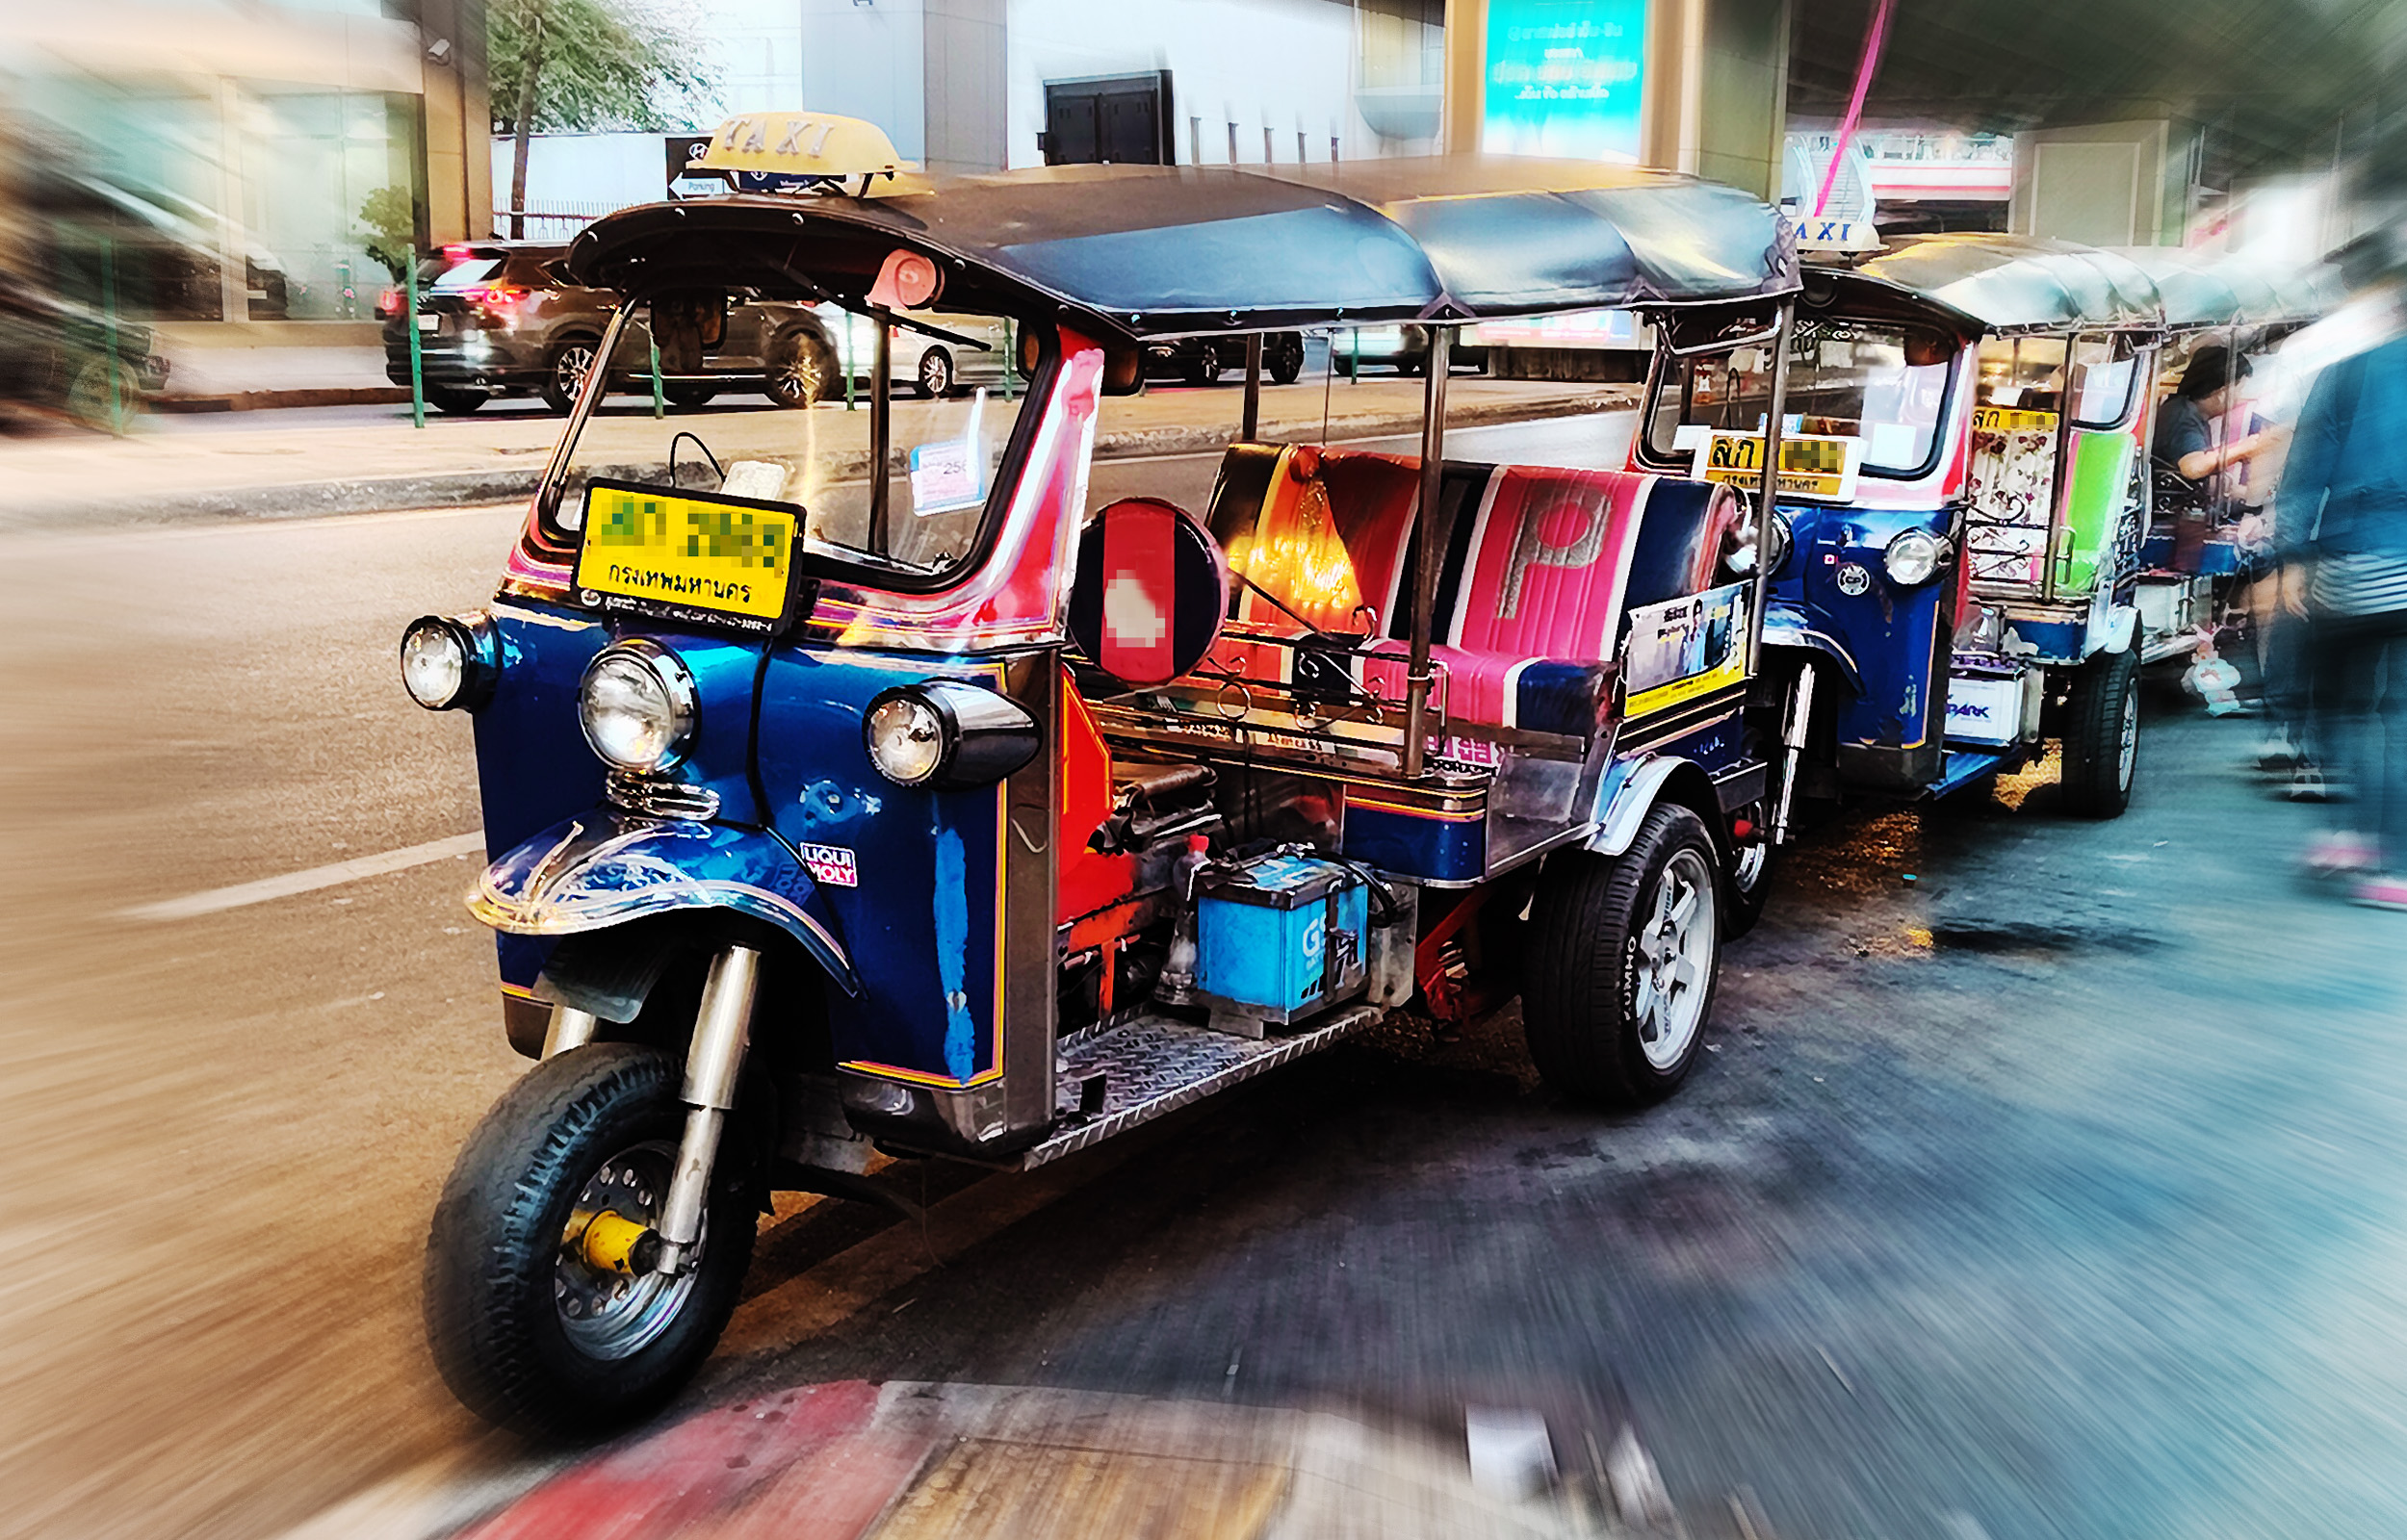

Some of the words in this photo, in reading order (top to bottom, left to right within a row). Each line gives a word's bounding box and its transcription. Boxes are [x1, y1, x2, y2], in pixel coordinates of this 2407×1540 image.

[723, 118, 835, 158] TAXI
[688, 180, 715, 192] Parking
[1795, 221, 1851, 241] AXI
[1497, 486, 1613, 619] P
[1946, 694, 1989, 721] PARK
[804, 847, 852, 867] LIQUI
[807, 862, 854, 883] MOLY
